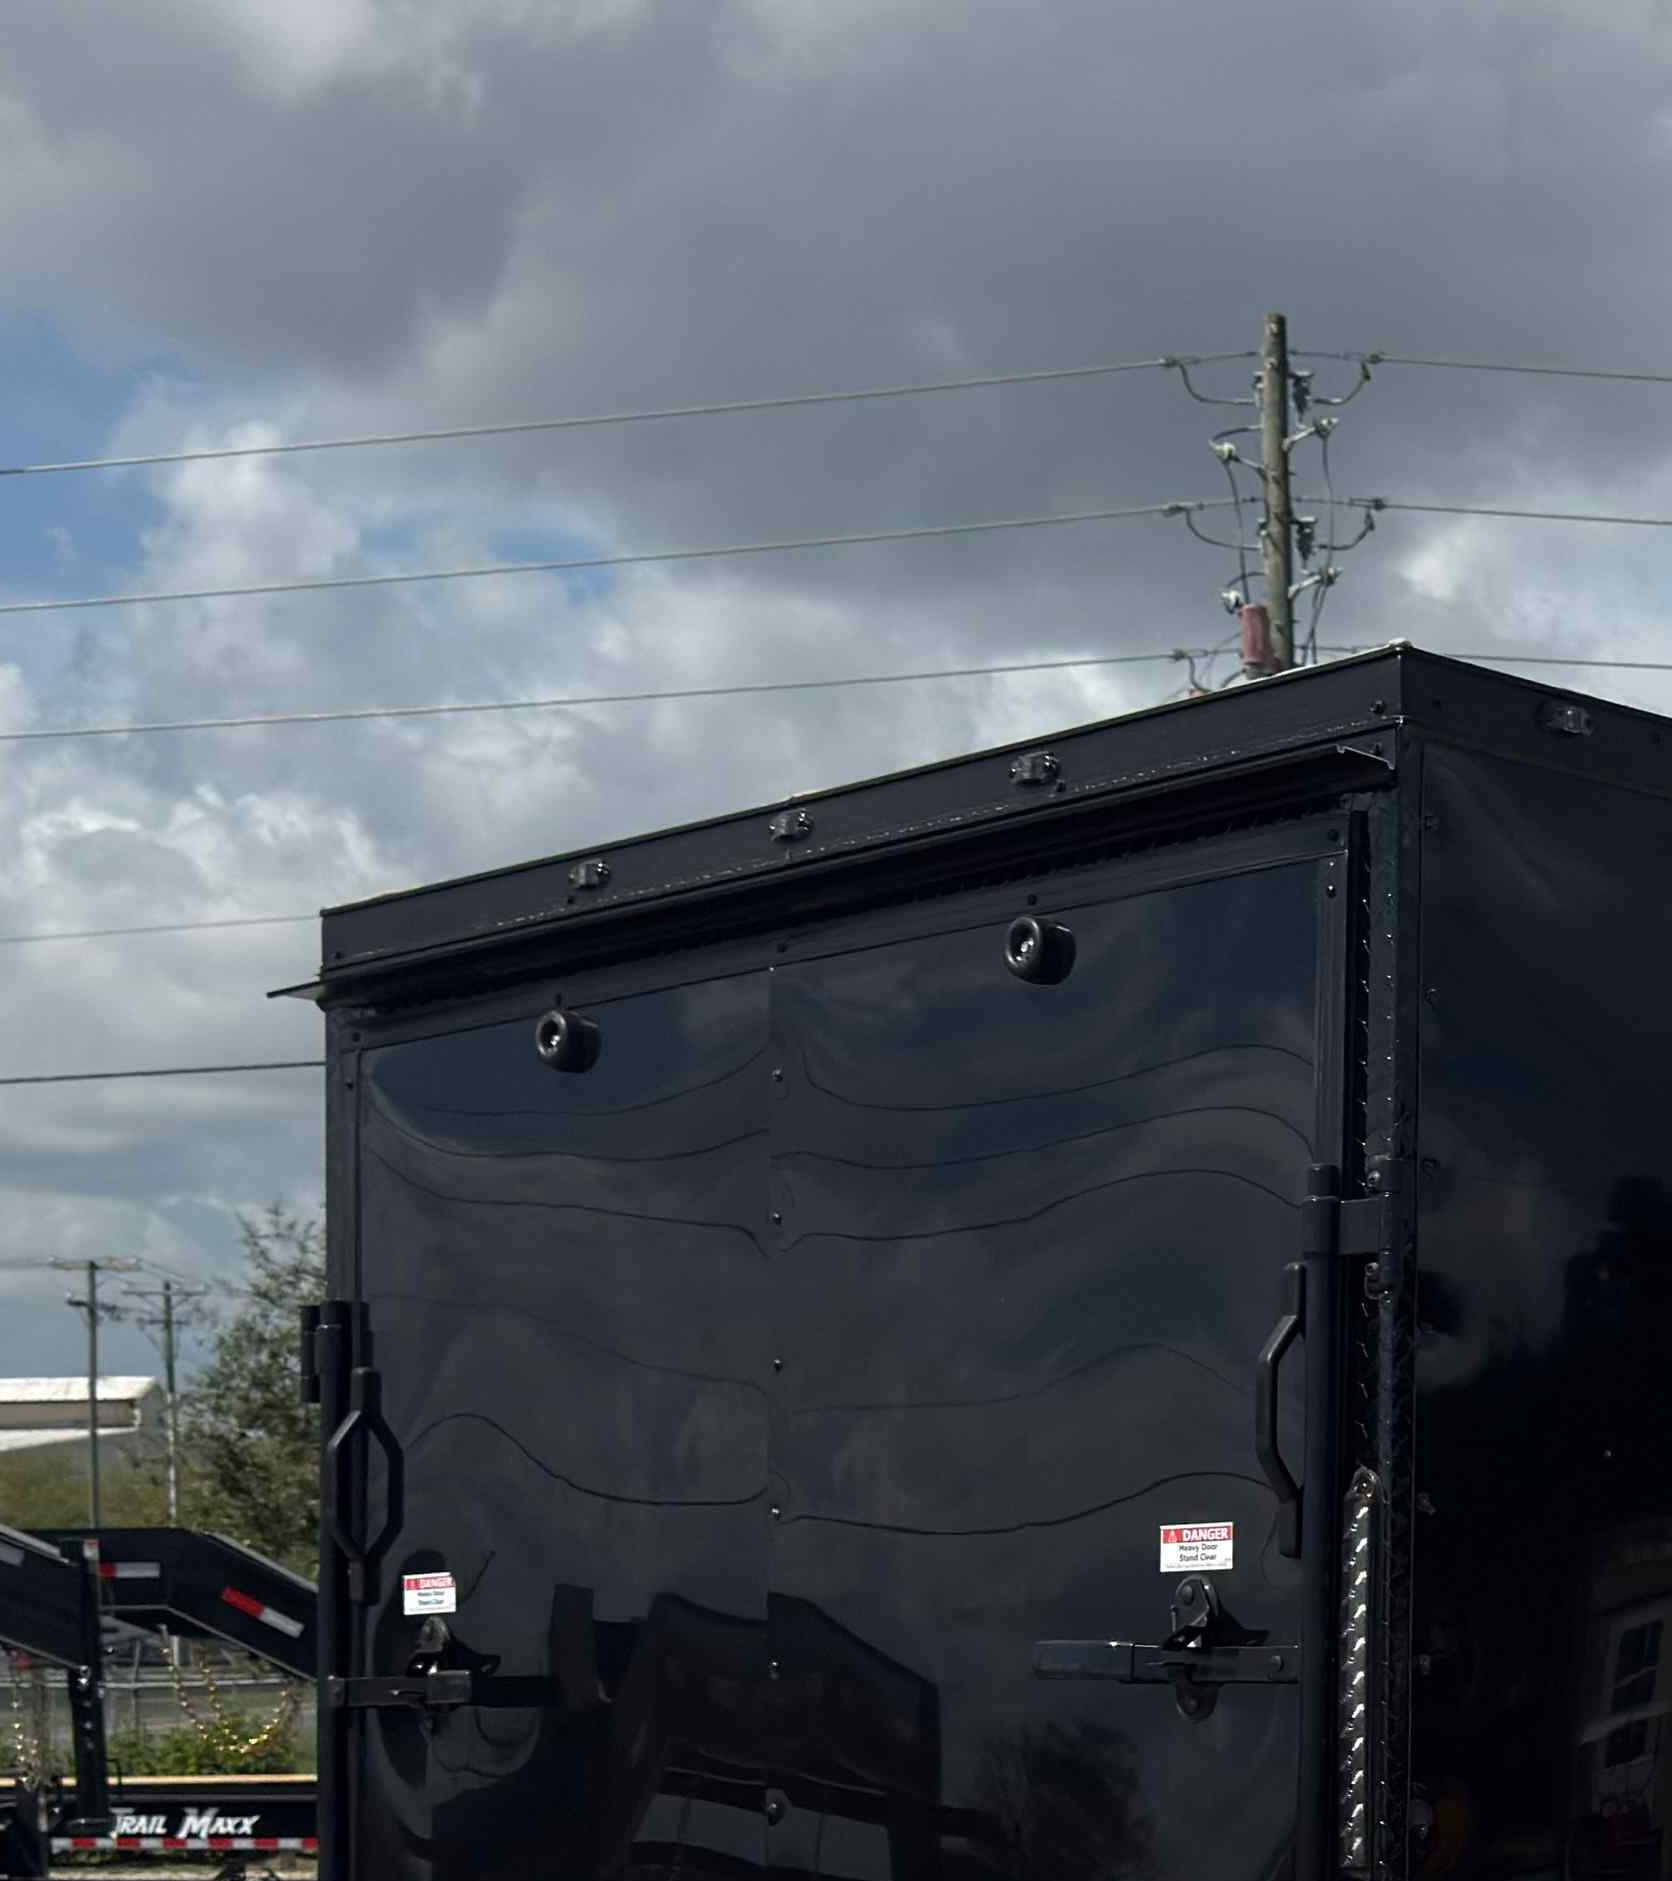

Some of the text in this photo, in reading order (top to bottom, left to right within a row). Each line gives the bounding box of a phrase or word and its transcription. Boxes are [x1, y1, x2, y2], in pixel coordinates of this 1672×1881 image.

[1183, 1527, 1229, 1542] DANGER
[109, 1807, 261, 1839] TRAIL MAXX
